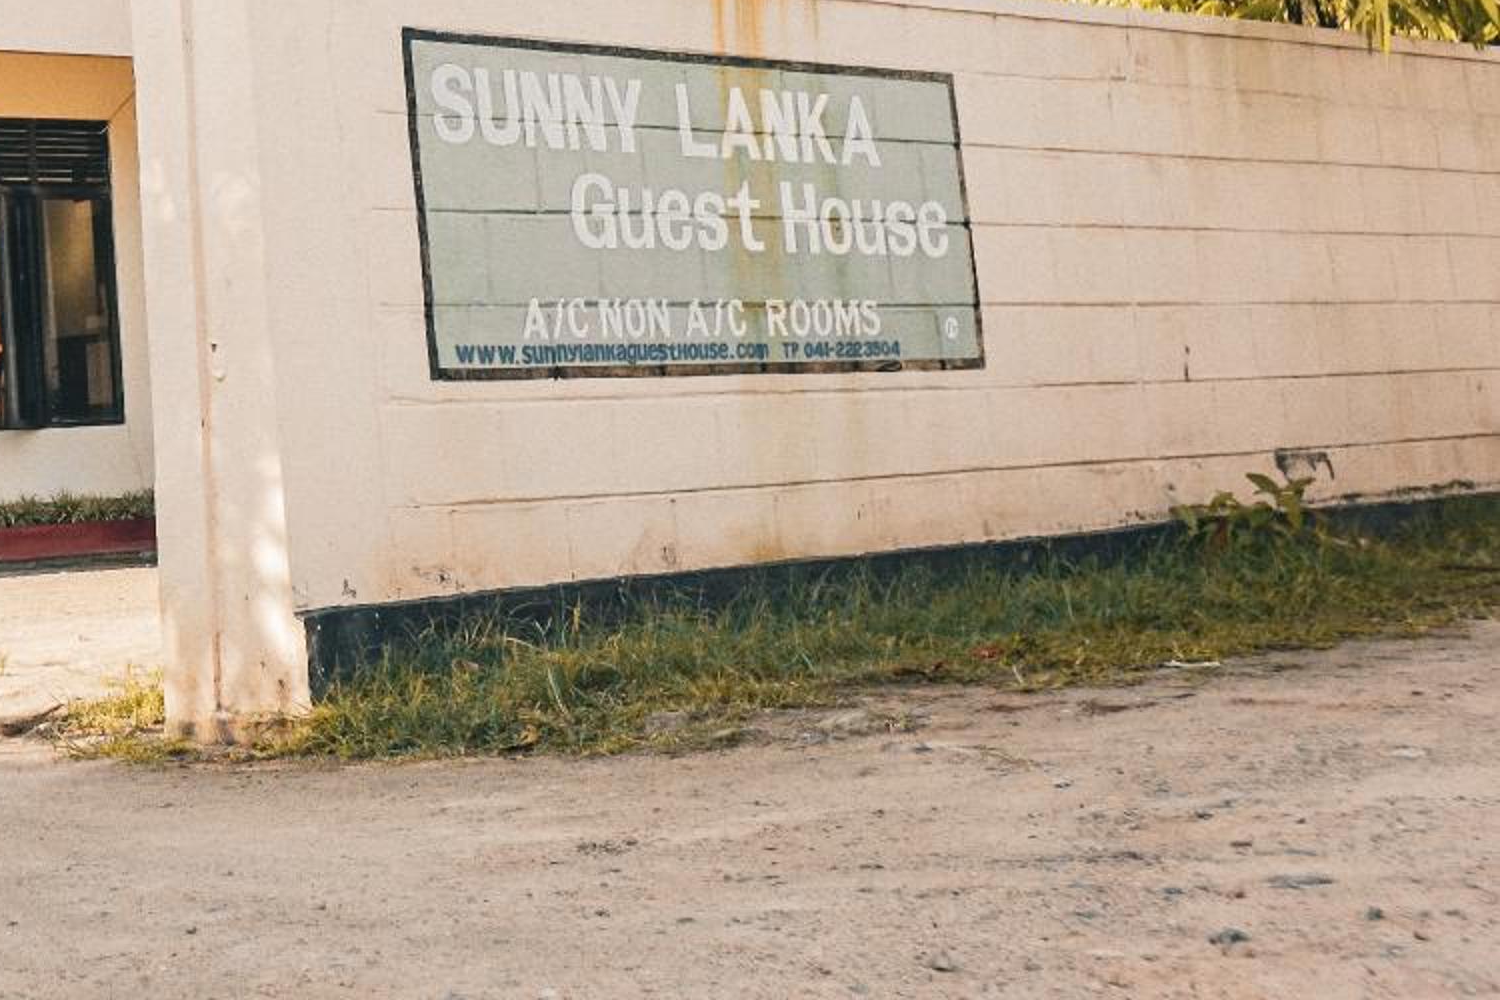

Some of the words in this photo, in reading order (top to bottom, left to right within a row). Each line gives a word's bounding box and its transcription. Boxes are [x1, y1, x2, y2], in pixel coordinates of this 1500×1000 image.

[429, 63, 641, 153] SUNNY
[674, 82, 882, 168] LANKA
[570, 172, 765, 252] Guest
[778, 181, 950, 259] House
[523, 297, 590, 340] A/C
[599, 297, 671, 339] NON
[686, 297, 747, 338] A/C
[765, 298, 882, 338] ROOMS
[803, 340, 901, 359] 041-2223504
